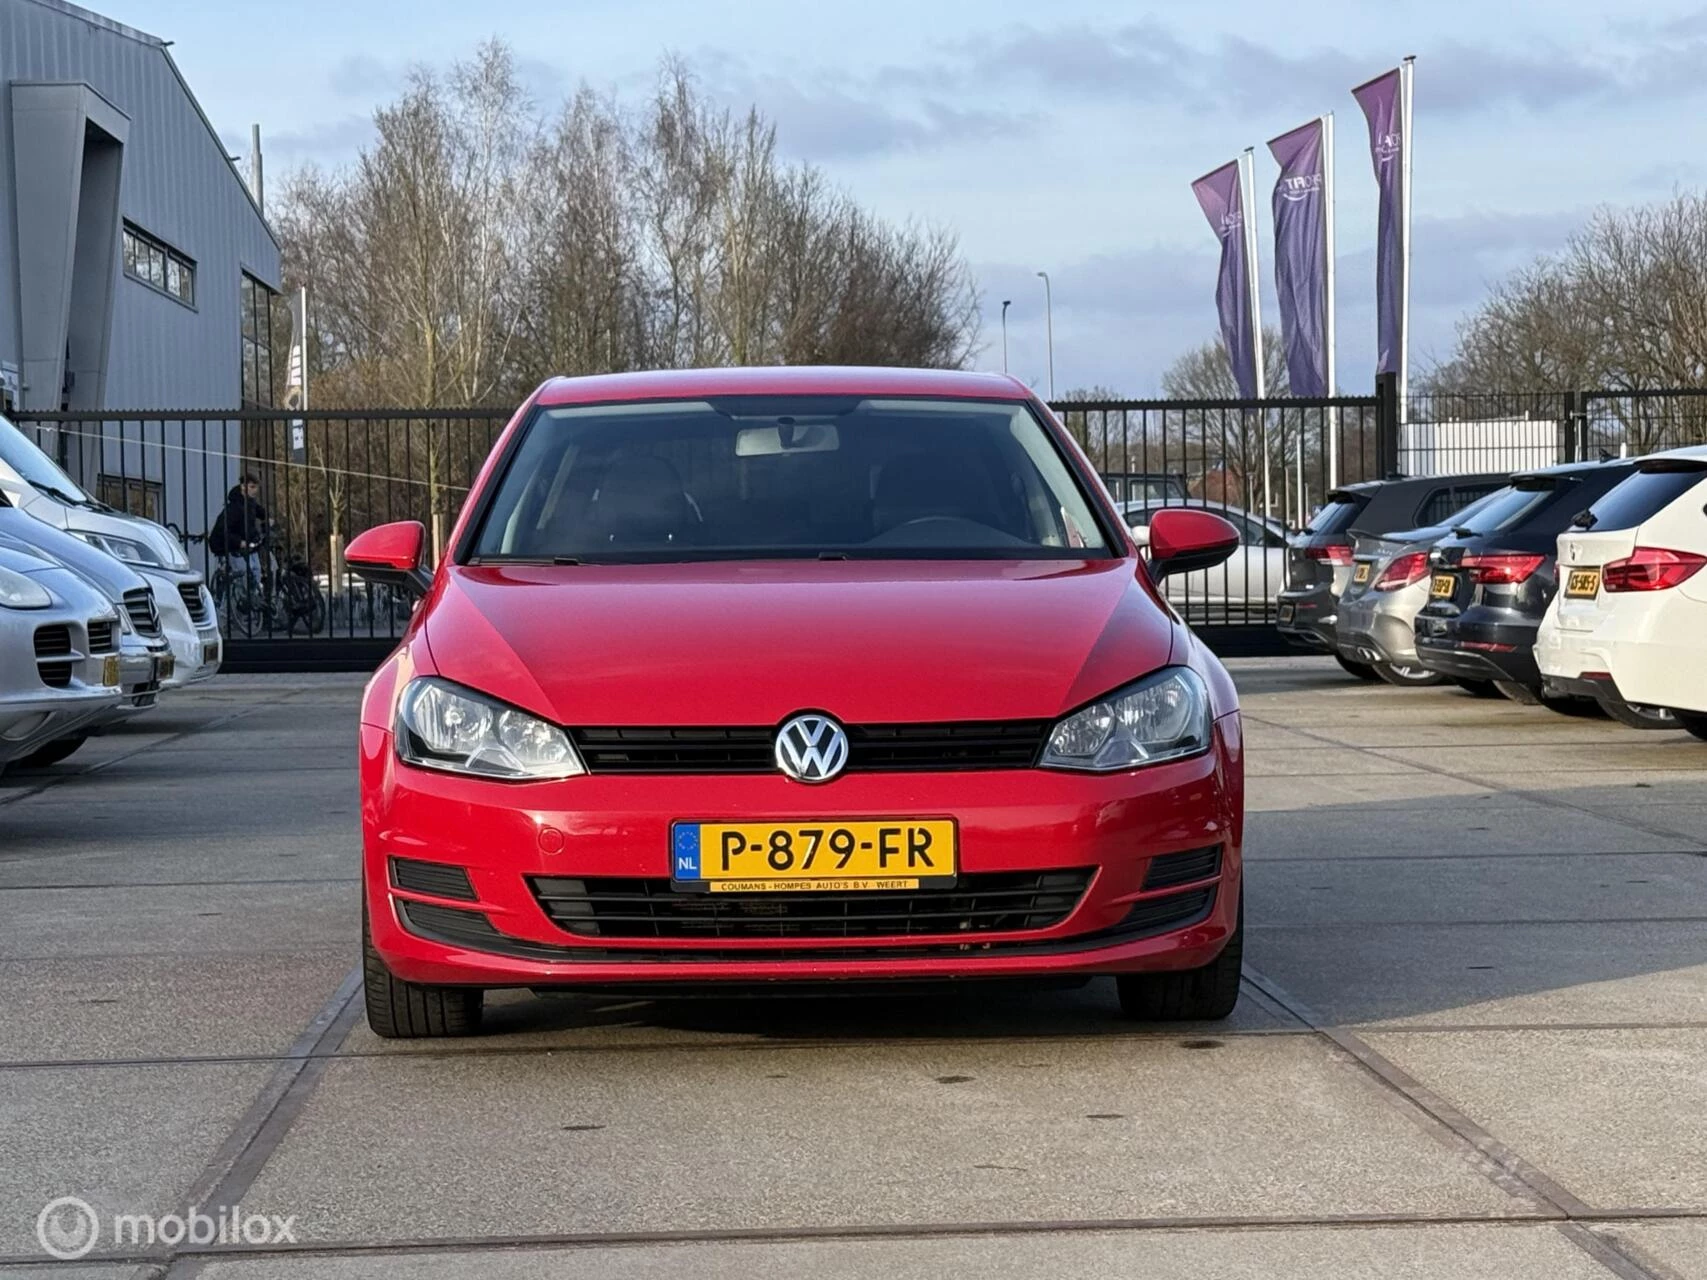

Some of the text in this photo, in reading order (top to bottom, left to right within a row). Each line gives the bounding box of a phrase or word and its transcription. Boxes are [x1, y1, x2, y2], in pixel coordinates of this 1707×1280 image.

[721, 827, 934, 871] P-879-FR
[678, 856, 697, 870] NL
[816, 881, 849, 890] AUTO'S
[876, 880, 908, 889] WEERT
